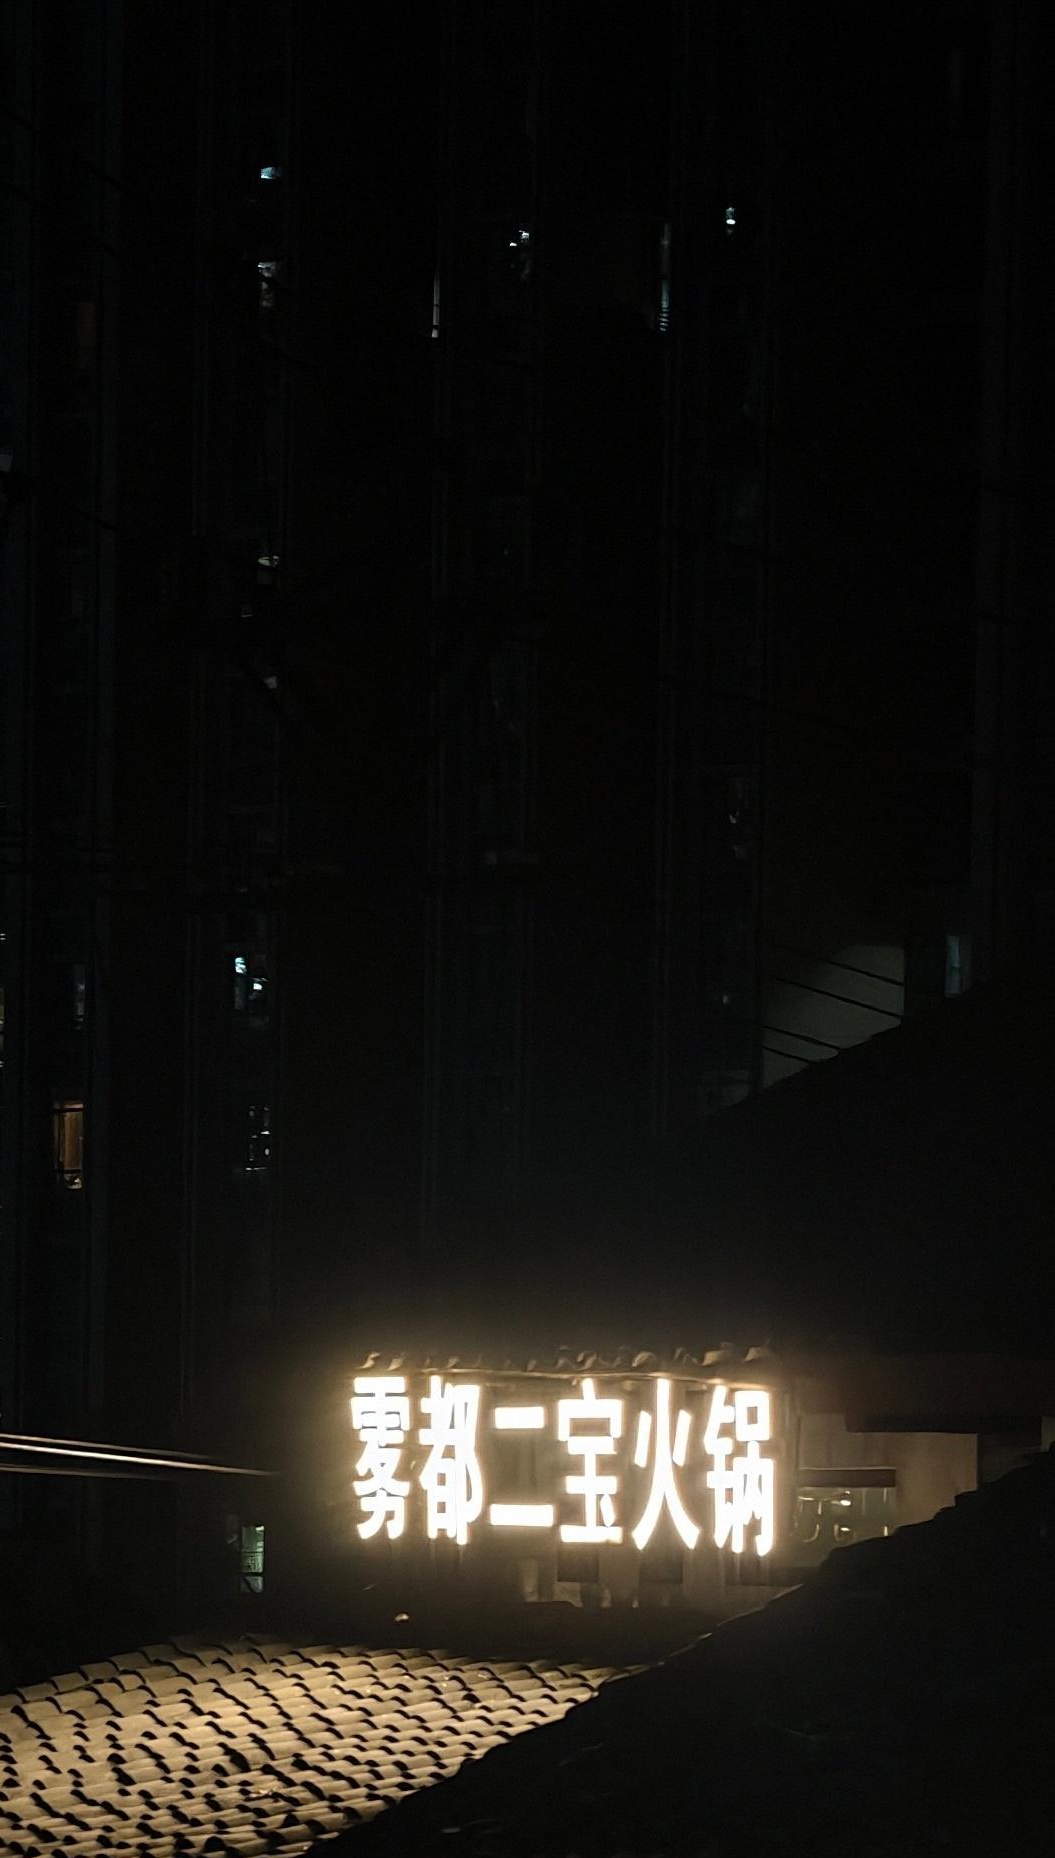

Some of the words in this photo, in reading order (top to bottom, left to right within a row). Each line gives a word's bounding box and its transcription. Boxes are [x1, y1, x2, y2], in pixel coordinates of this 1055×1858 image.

[350, 1375, 776, 1557] 雾都二宝火锅
